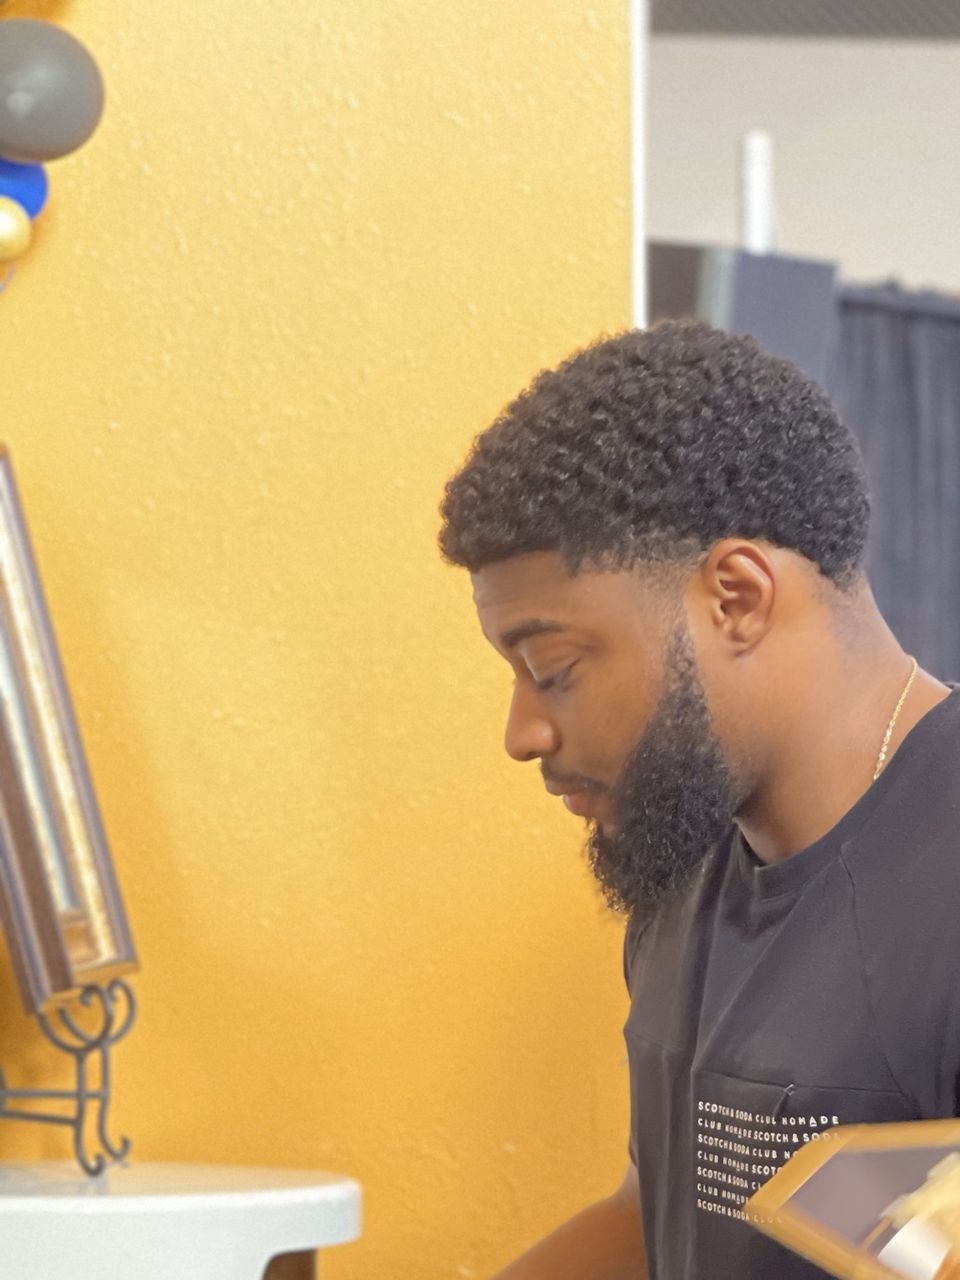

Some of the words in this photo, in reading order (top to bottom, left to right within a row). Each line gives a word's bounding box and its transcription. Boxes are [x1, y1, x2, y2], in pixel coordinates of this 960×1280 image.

[782, 1115, 839, 1127] NOMADE
[697, 1118, 722, 1130] CLUB
[725, 1124, 752, 1138] NOMADE
[753, 1130, 789, 1143] SCOTCH
[697, 1150, 719, 1163] CLUB
[752, 1148, 778, 1159] CLUB
[697, 1183, 718, 1196] CLUB
